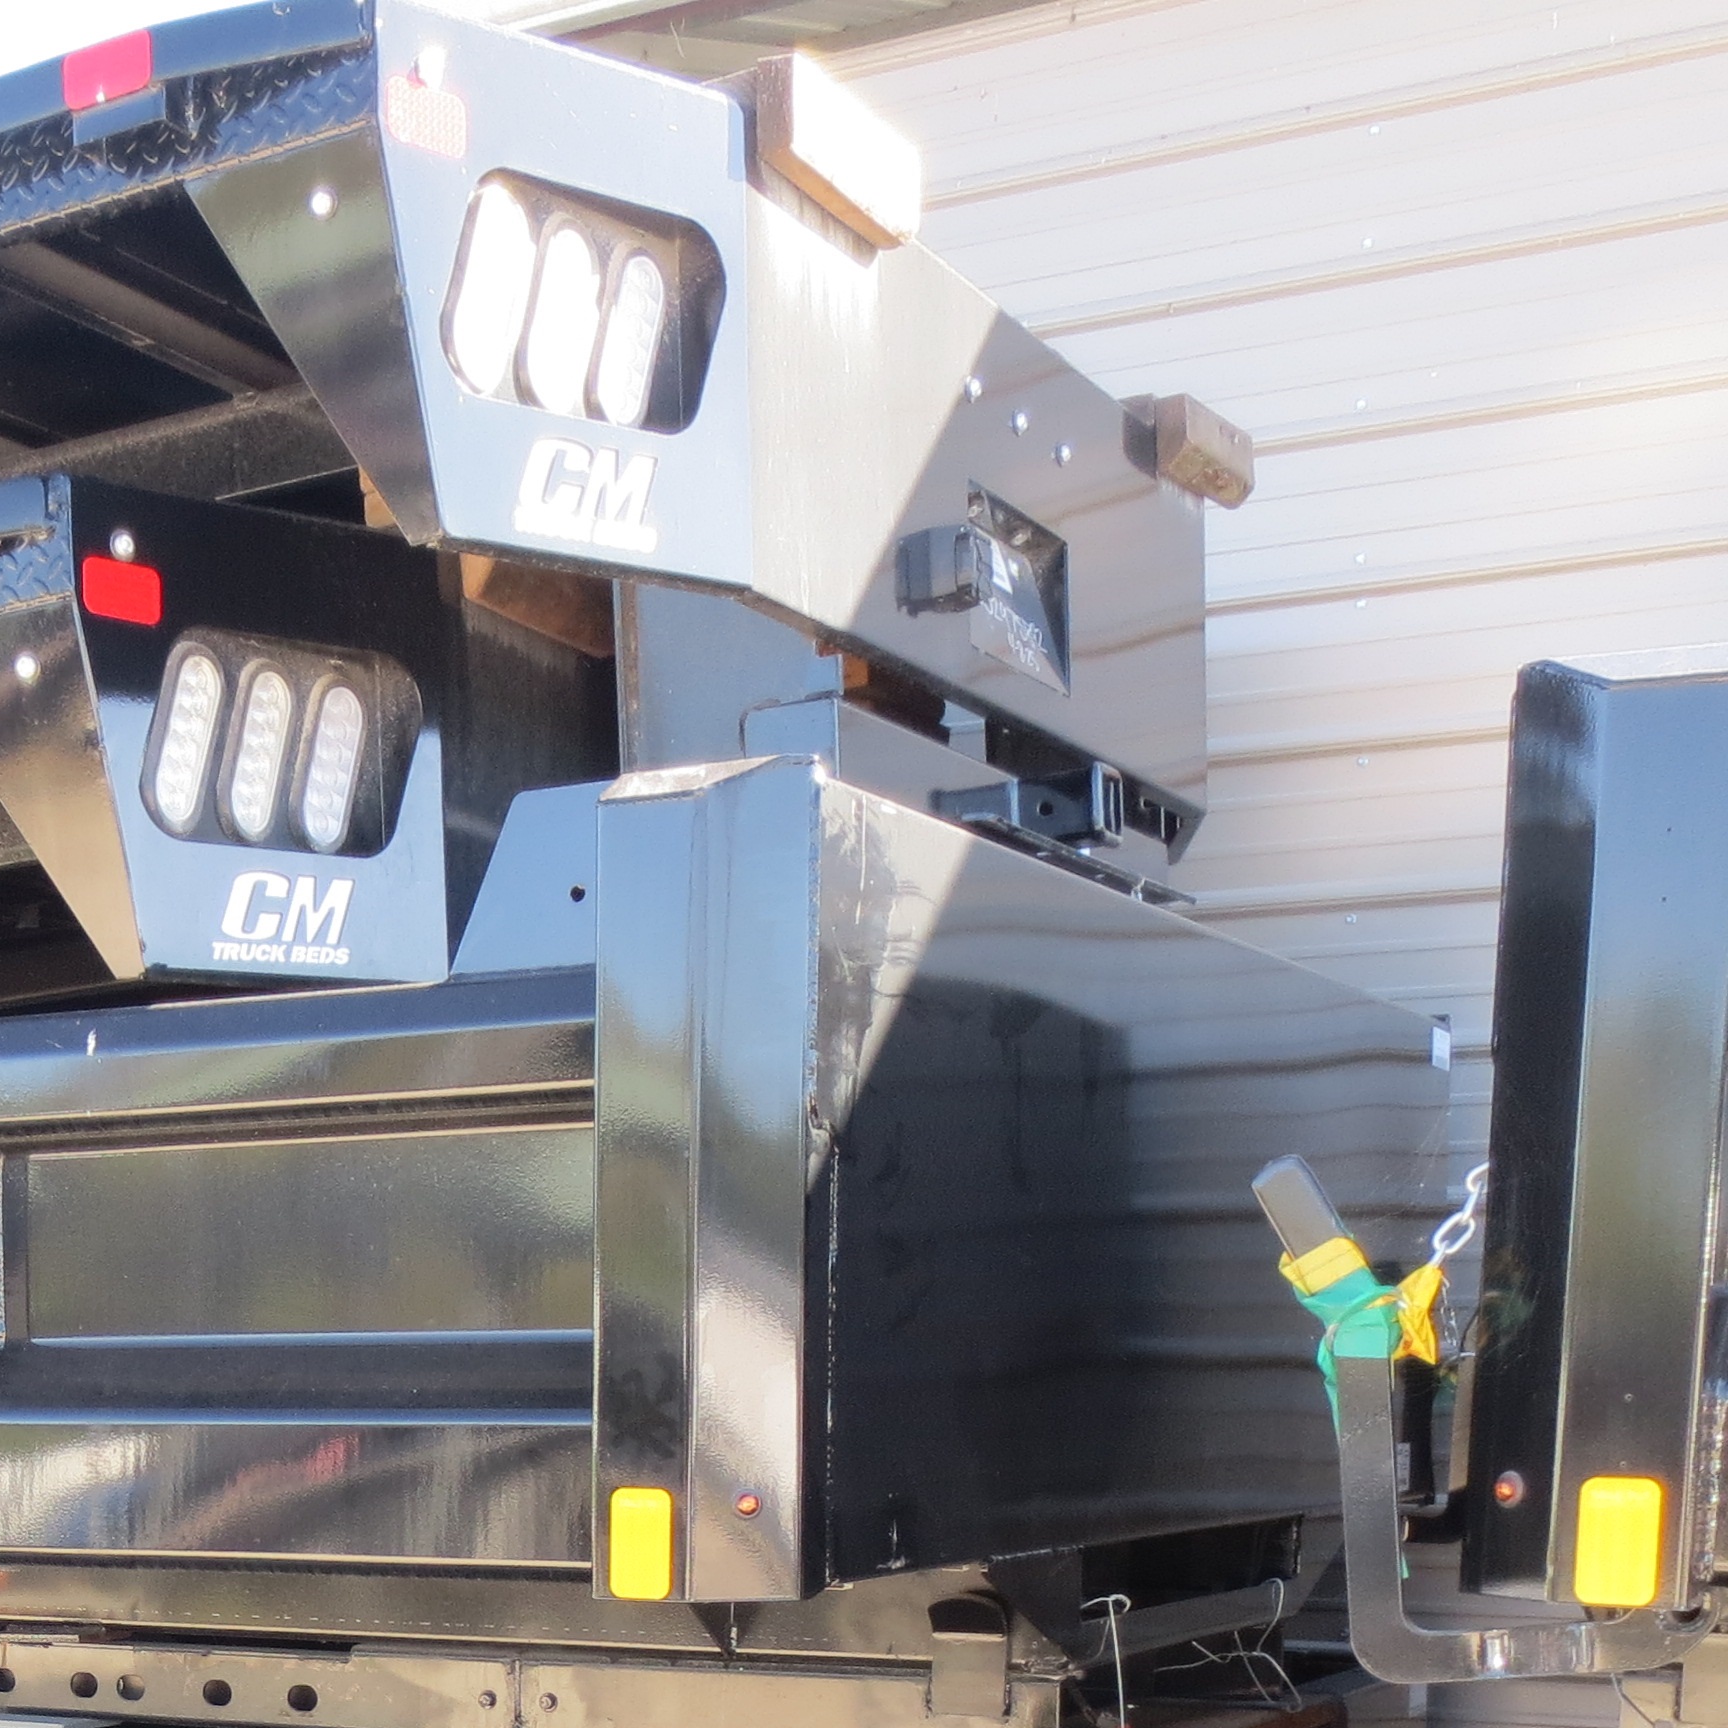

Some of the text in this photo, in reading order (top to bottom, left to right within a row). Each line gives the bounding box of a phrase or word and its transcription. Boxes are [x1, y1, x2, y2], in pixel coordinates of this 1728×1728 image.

[518, 436, 658, 527] CM
[221, 870, 355, 945] CM
[211, 941, 351, 966] TRUCK BEDS
